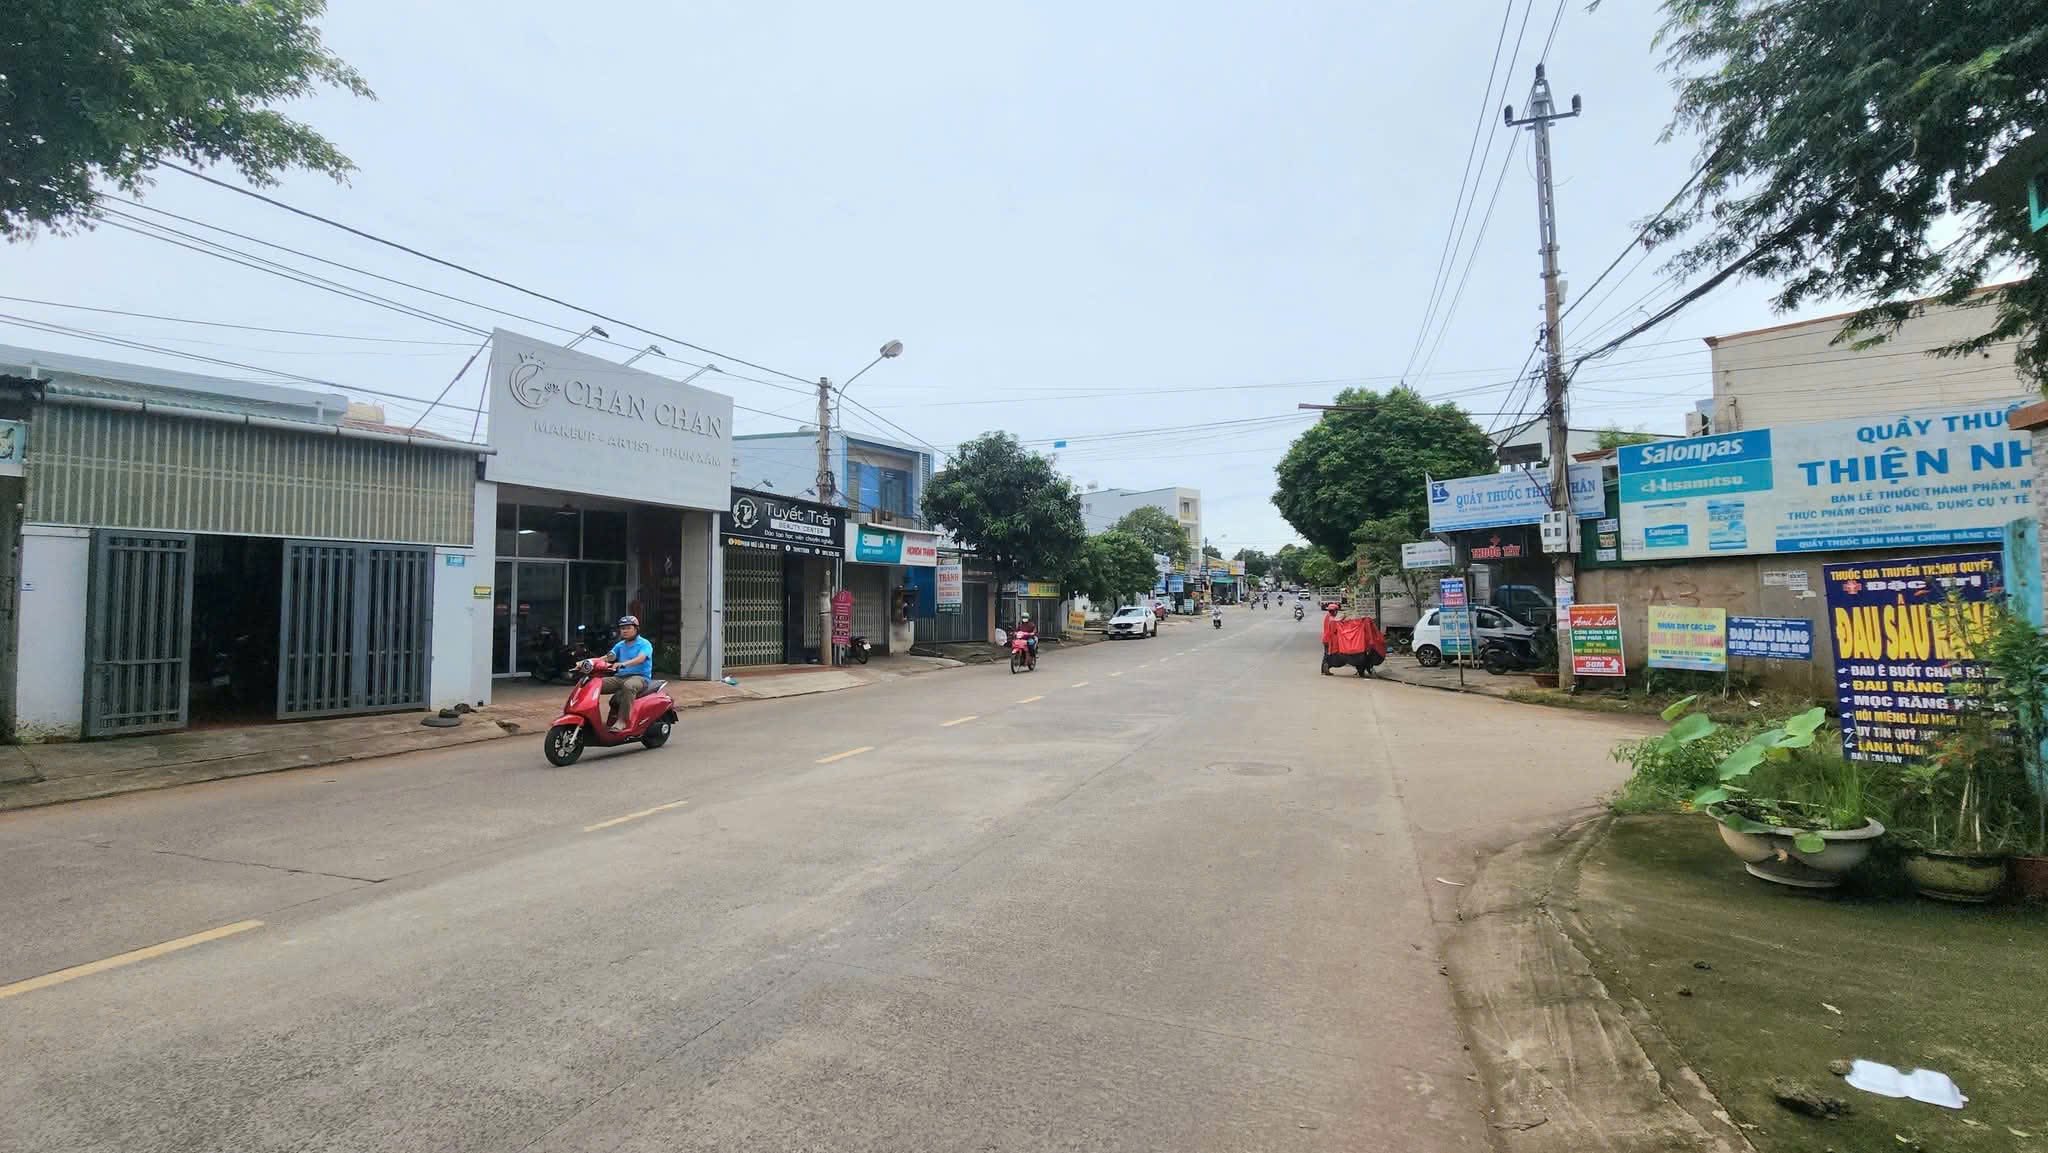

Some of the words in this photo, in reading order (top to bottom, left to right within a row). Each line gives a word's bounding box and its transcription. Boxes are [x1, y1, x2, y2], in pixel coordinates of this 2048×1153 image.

[564, 381, 646, 423] CHAN
[654, 404, 722, 440] CHAN
[534, 420, 596, 443] MAKEUP
[607, 436, 650, 454] ARTIST
[1856, 415, 1932, 443] QUẦY
[1640, 438, 1744, 465] Salonpas
[1798, 446, 1950, 487] THIỆN
[1969, 440, 2032, 472] NH
[1487, 484, 1522, 502] THUỐC
[1568, 478, 1596, 494] HÂN
[1642, 476, 1744, 493] Hisamitsu
[1831, 492, 1855, 504] BÁN
[1878, 486, 1920, 501] THUỐC
[1924, 482, 1968, 498] THÀNH
[2020, 478, 2032, 489] M
[764, 502, 804, 522] Tuyết
[1788, 510, 1818, 522] THỰC
[1999, 496, 2008, 506] Y
[802, 526, 824, 535] CENTER
[1826, 534, 1860, 548] THUỐC
[1830, 566, 1862, 581] THUỐC
[1862, 567, 1880, 579] GIA
[1881, 563, 1920, 578] TRUYỀN
[1959, 558, 1994, 573] QUYẾT
[1729, 628, 1752, 640] ĐAU
[1753, 626, 1776, 641] SÂU
[1776, 628, 1809, 644] RĂNG
[1834, 606, 1883, 660] ĐAU
[1883, 593, 1930, 661] SÂU
[1850, 665, 1876, 676] ĐAU
[1889, 663, 1922, 678] BUỐT
[1852, 680, 1888, 692] ĐAU
[1892, 679, 1945, 694] RĂNG
[1854, 695, 1893, 708] MỌC
[1898, 695, 1949, 710] RĂNG
